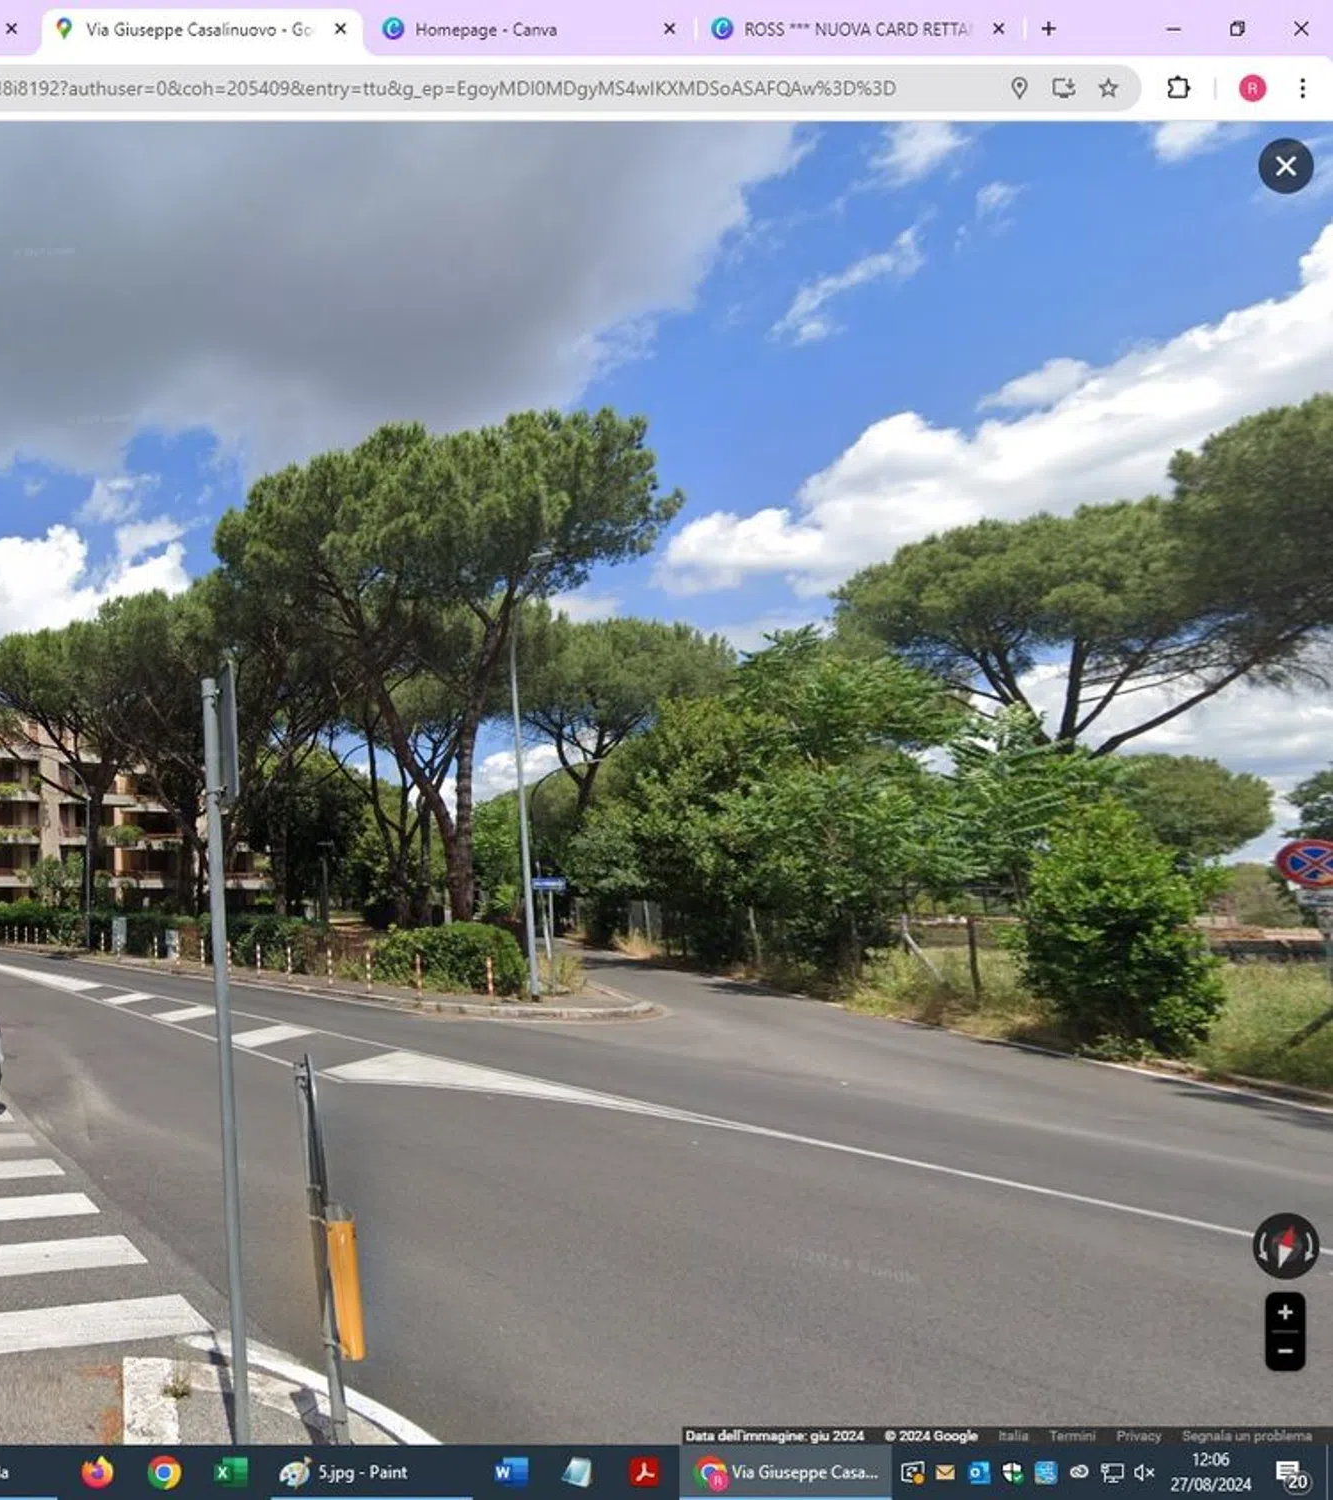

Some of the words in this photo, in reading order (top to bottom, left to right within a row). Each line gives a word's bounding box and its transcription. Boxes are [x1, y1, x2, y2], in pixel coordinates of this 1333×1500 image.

[87, 22, 109, 36] Via
[114, 22, 183, 40] Giuseppe
[187, 22, 276, 36] Casalinuovo
[416, 22, 497, 40] Homepage
[513, 22, 557, 36] Canva
[745, 22, 784, 36] ROSS
[816, 22, 871, 36] NUOVA
[876, 22, 918, 36] CARD
[686, 1430, 715, 1442] Data
[810, 1430, 830, 1445] giu
[833, 1430, 865, 1442] 2024
[900, 1430, 931, 1442] 2024
[934, 1430, 979, 1445] Google
[998, 1430, 1029, 1442] Italia
[1050, 1430, 1096, 1442] Termini
[1117, 1430, 1162, 1445] Privacy
[1183, 1429, 1232, 1445] Segnala
[1236, 1433, 1251, 1442] un
[1254, 1429, 1313, 1445] problema
[1192, 1452, 1230, 1467] 12:06
[320, 1464, 355, 1484] 5.jpg
[370, 1464, 408, 1480] Paint
[732, 1464, 755, 1479] Via
[759, 1464, 827, 1483] Giuseppe
[832, 1464, 878, 1480] Casa...
[1170, 1476, 1252, 1493] 27/08/2024
[1288, 1475, 1308, 1489] 20
